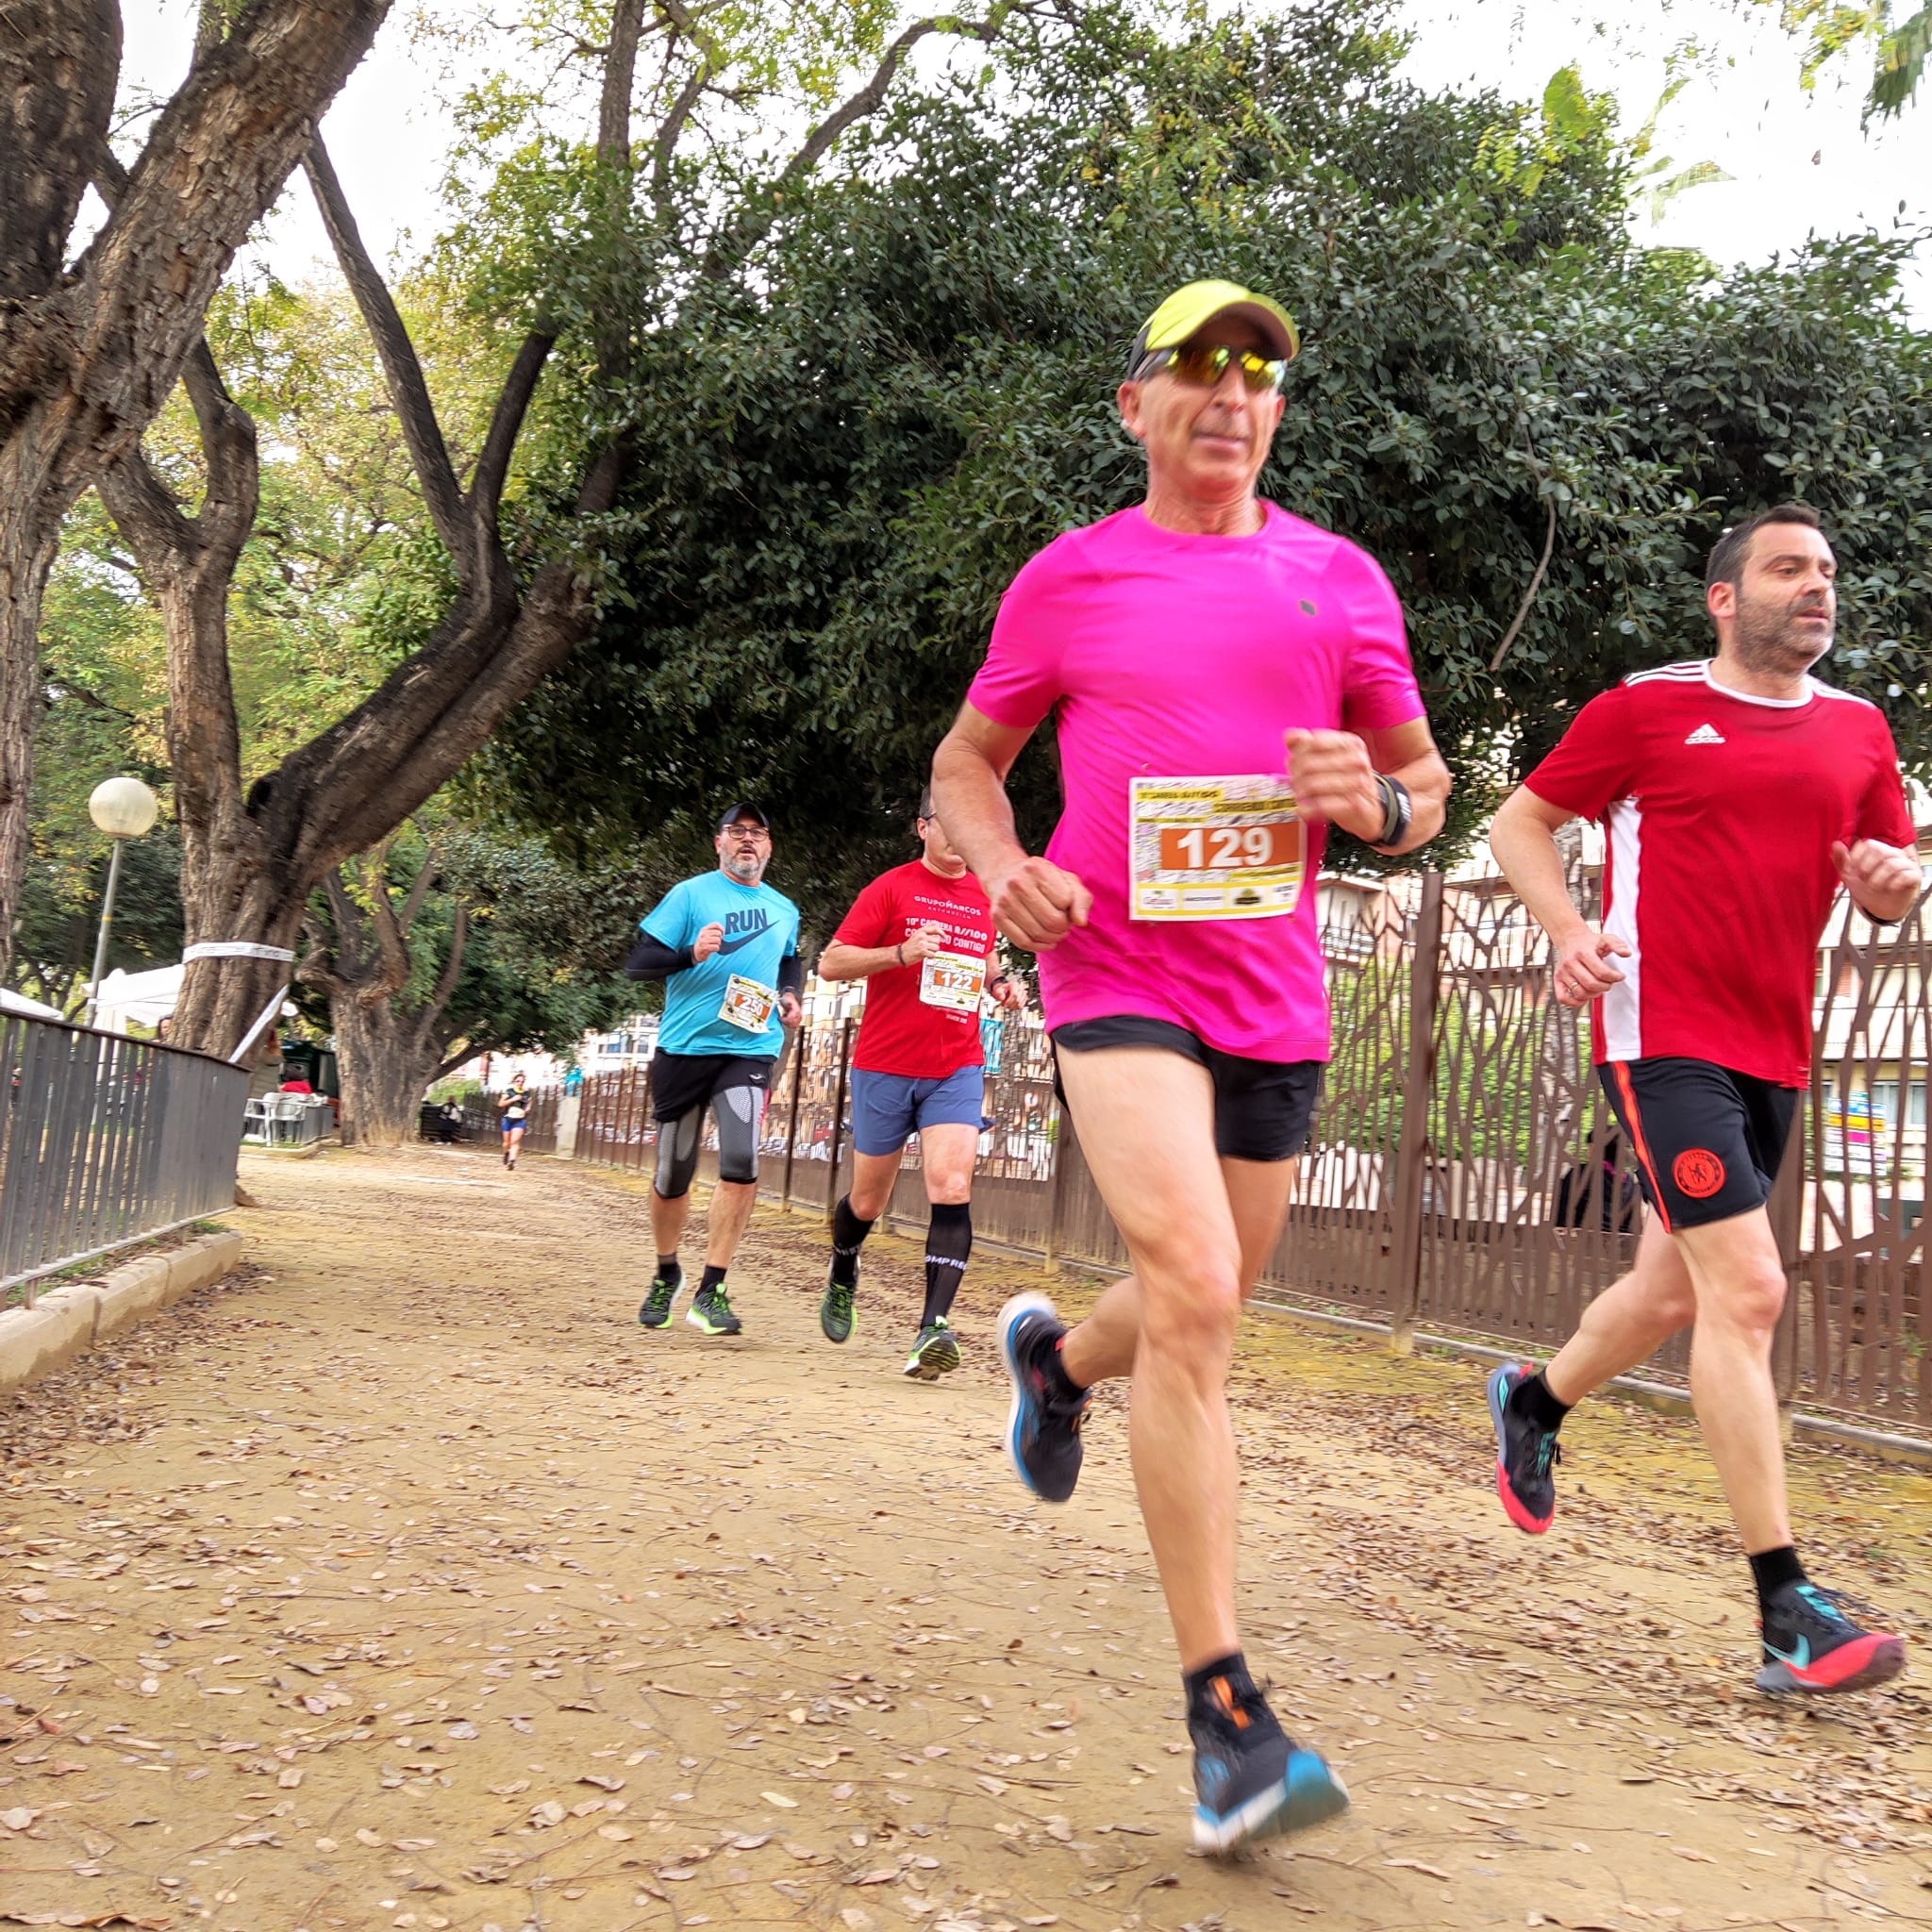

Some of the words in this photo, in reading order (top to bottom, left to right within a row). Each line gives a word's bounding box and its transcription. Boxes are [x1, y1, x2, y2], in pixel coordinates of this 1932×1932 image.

[1176, 826, 1274, 869] 129
[724, 908, 769, 936] RUN
[941, 972, 974, 991] 122
[739, 994, 764, 1017] 250
